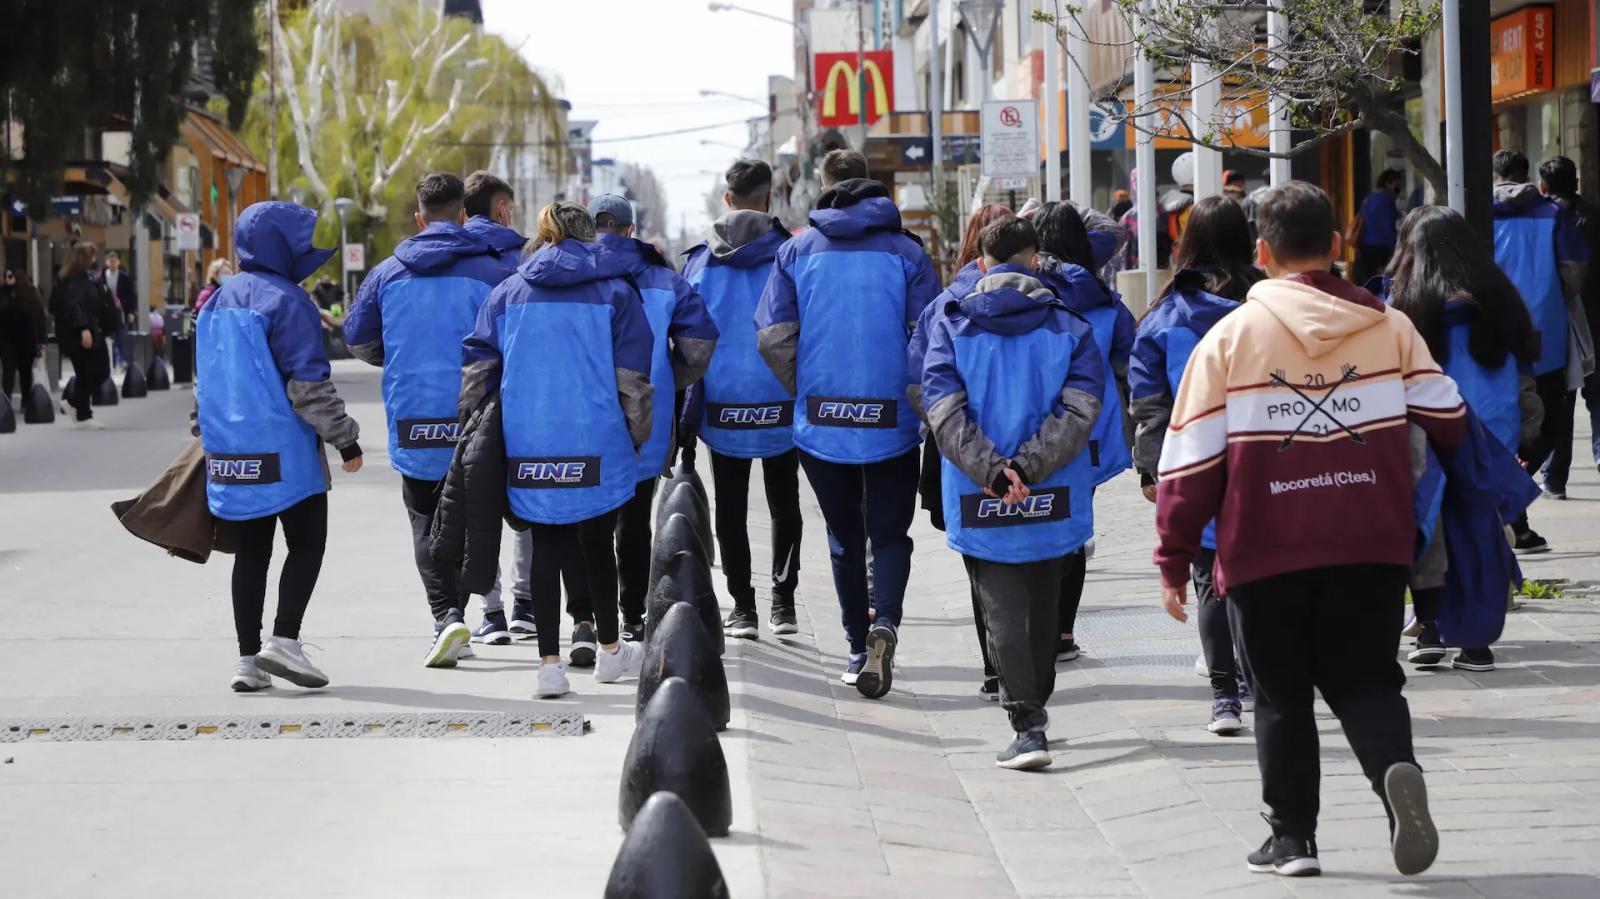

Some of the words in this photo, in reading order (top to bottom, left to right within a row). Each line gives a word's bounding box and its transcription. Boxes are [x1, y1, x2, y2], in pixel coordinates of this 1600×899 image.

[1535, 13, 1544, 39] CAR
[1502, 25, 1522, 52] RENT
[1535, 41, 1544, 50] A
[1304, 373, 1325, 388] 20
[720, 406, 782, 422] FINE
[818, 402, 884, 419] FINE
[1267, 401, 1306, 420] PRO
[1332, 397, 1361, 413] MO
[409, 423, 464, 440] FIN
[1313, 424, 1329, 438] 21
[210, 460, 262, 477] FINE
[518, 462, 586, 480] FINE
[1270, 473, 1333, 495] Mocoretá
[1334, 469, 1376, 487] (Ctes.)
[978, 494, 1055, 518] FINE
